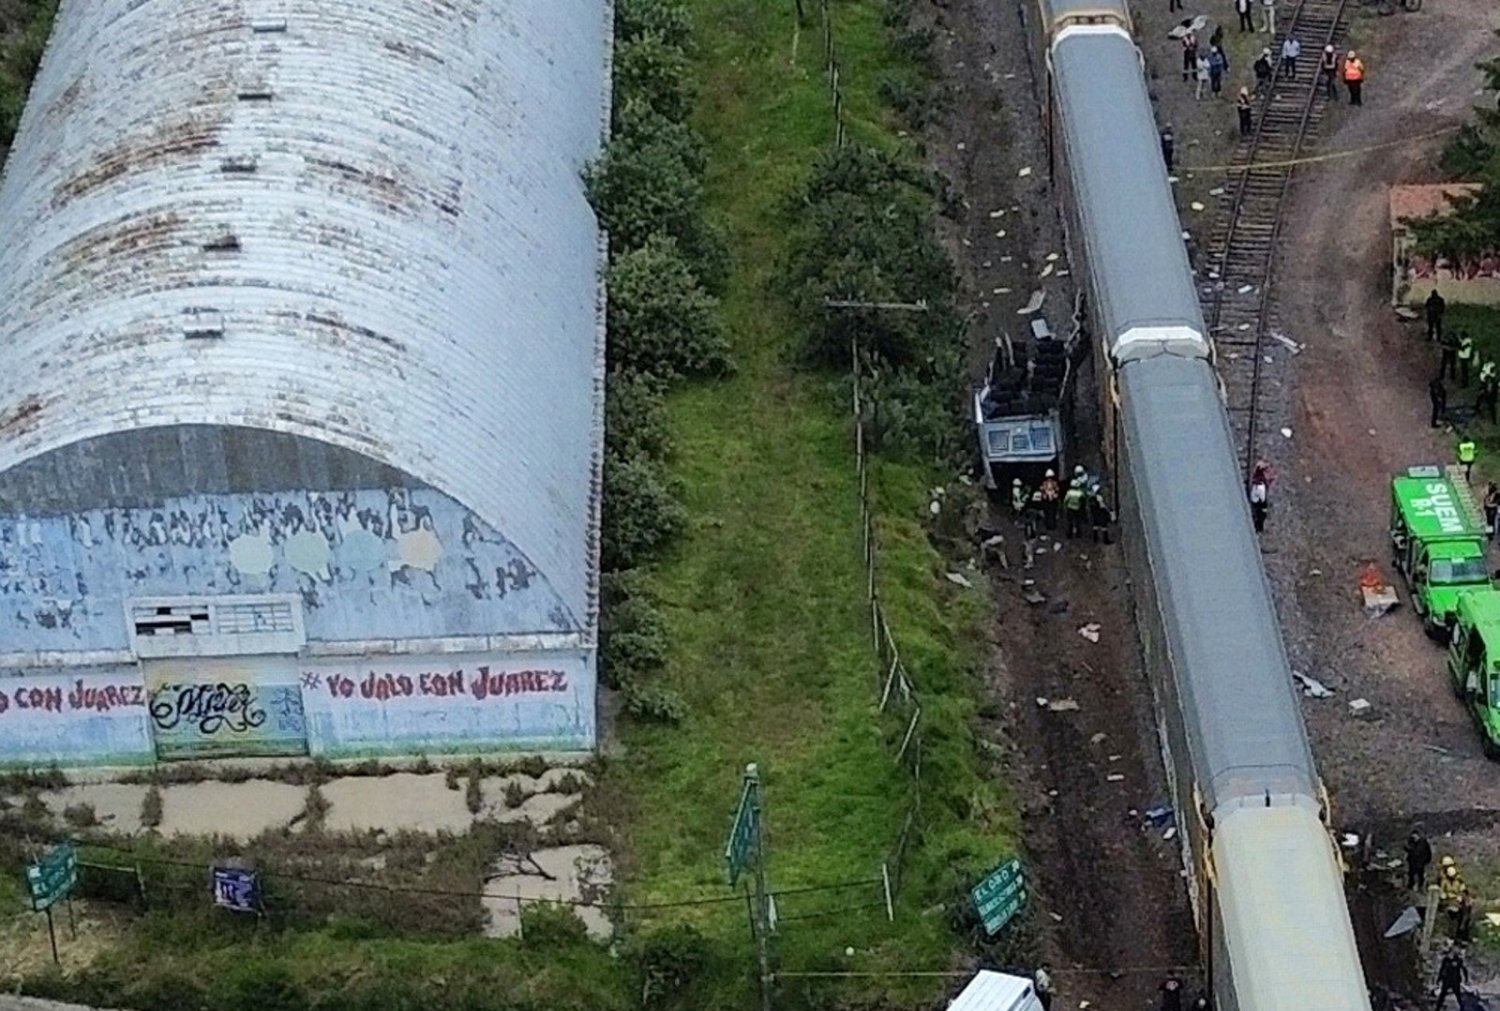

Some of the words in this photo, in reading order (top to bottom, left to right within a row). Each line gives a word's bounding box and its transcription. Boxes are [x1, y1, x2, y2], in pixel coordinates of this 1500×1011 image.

[1425, 482, 1464, 532] SUEM
[14, 686, 62, 713] CON
[68, 679, 145, 712] JUAREZ
[326, 673, 355, 698] YO
[471, 666, 569, 701] JUAREZ
